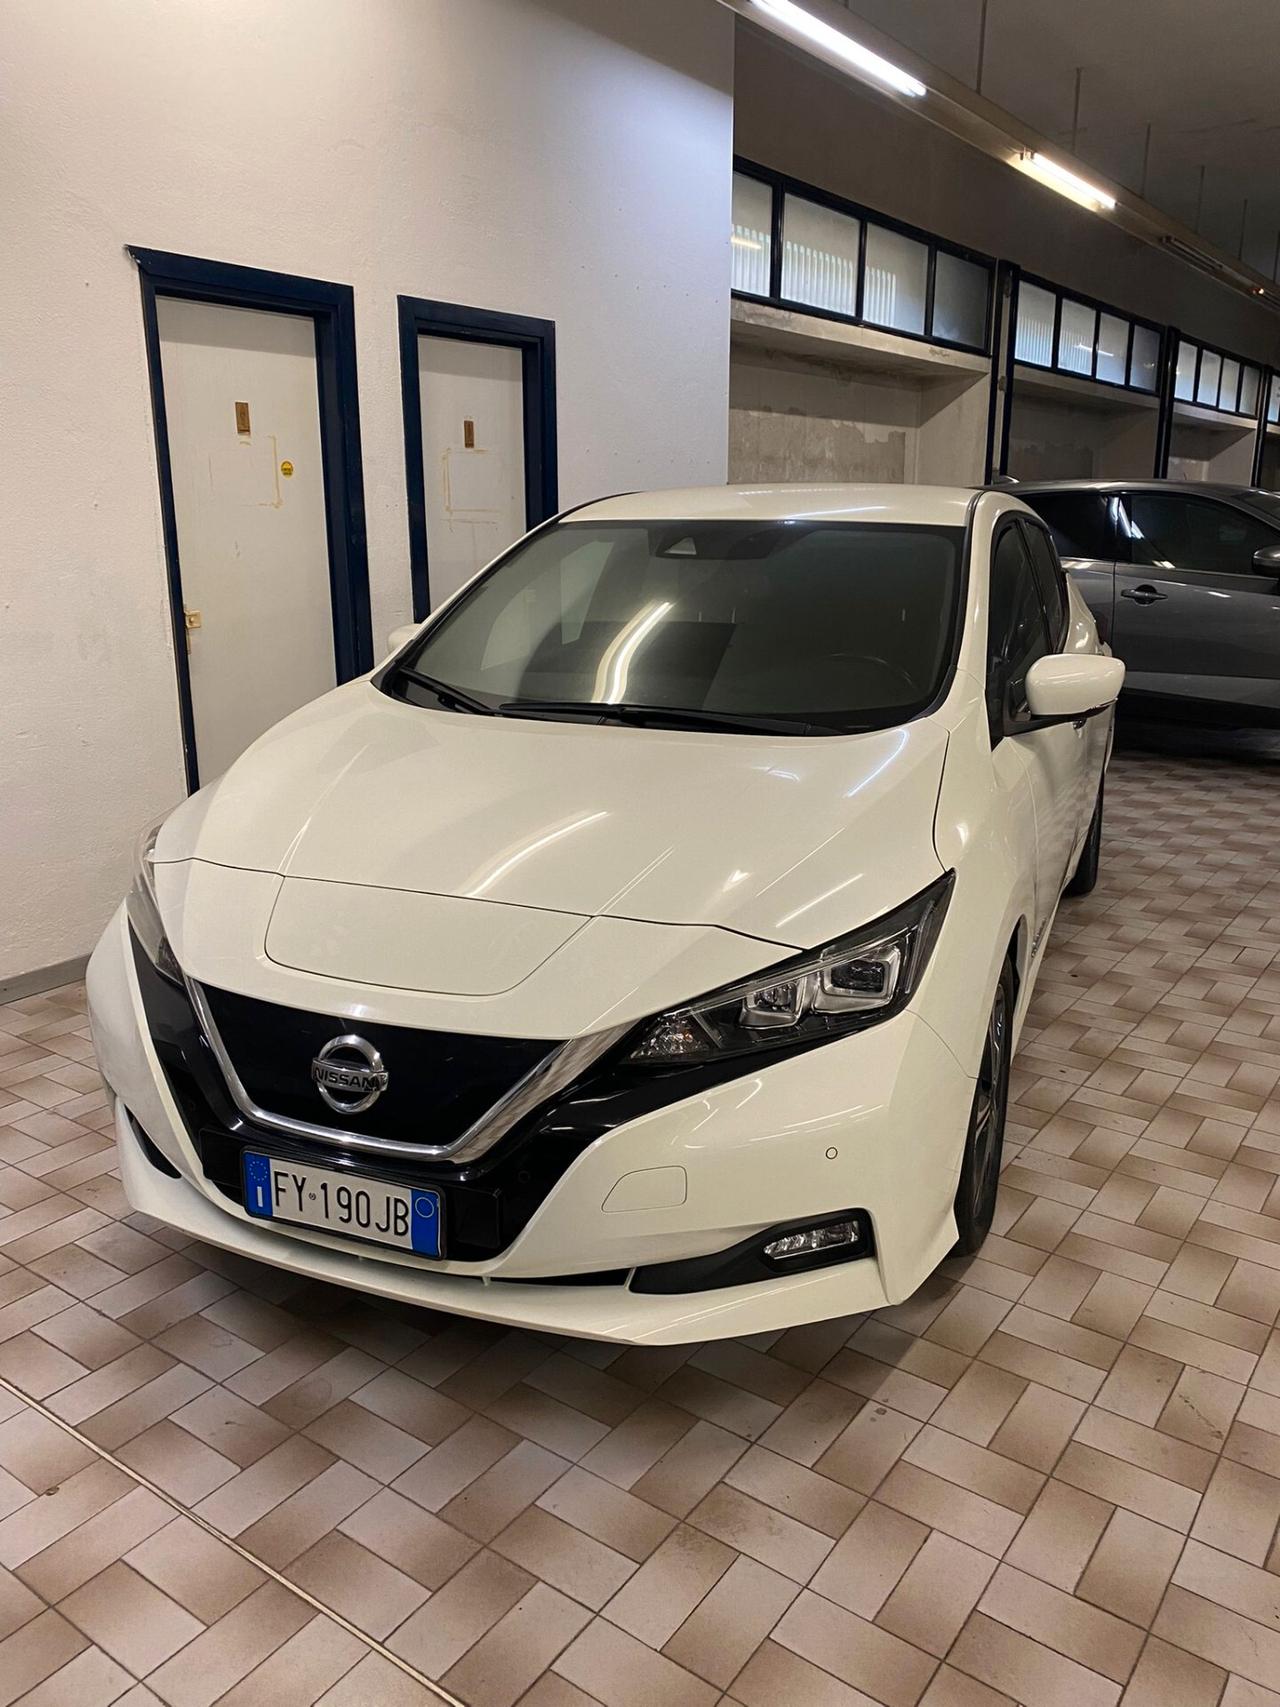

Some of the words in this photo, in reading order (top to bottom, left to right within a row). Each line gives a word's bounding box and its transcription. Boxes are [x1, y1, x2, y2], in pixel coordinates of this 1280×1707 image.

[315, 1067, 380, 1092] NISSAN
[274, 1171, 307, 1212] FY
[320, 1182, 409, 1236] 190JB
